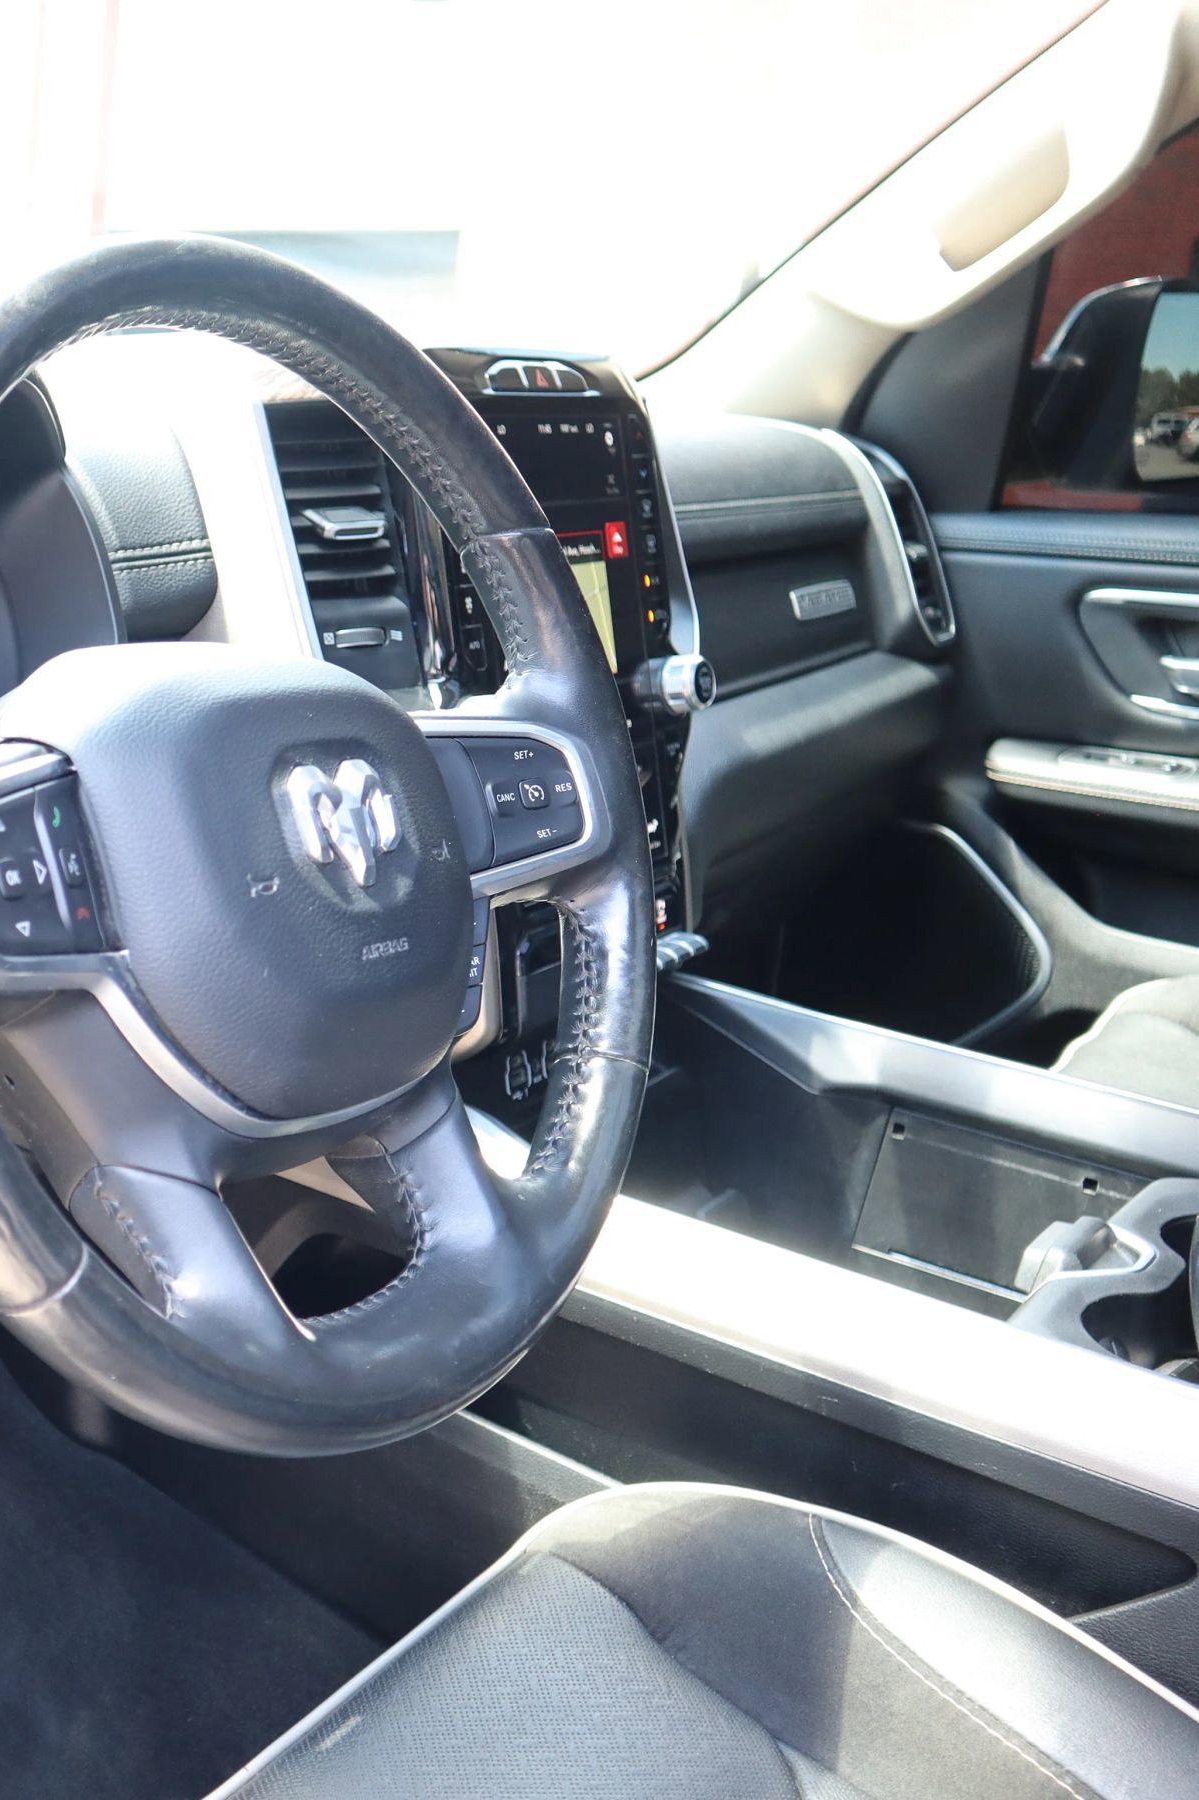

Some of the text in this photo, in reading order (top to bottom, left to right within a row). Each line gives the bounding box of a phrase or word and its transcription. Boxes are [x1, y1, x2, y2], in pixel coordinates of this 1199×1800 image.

[513, 750, 534, 760] SET+
[555, 783, 573, 793] RES
[496, 792, 516, 802] CANC
[361, 937, 409, 960] AIRBAG
